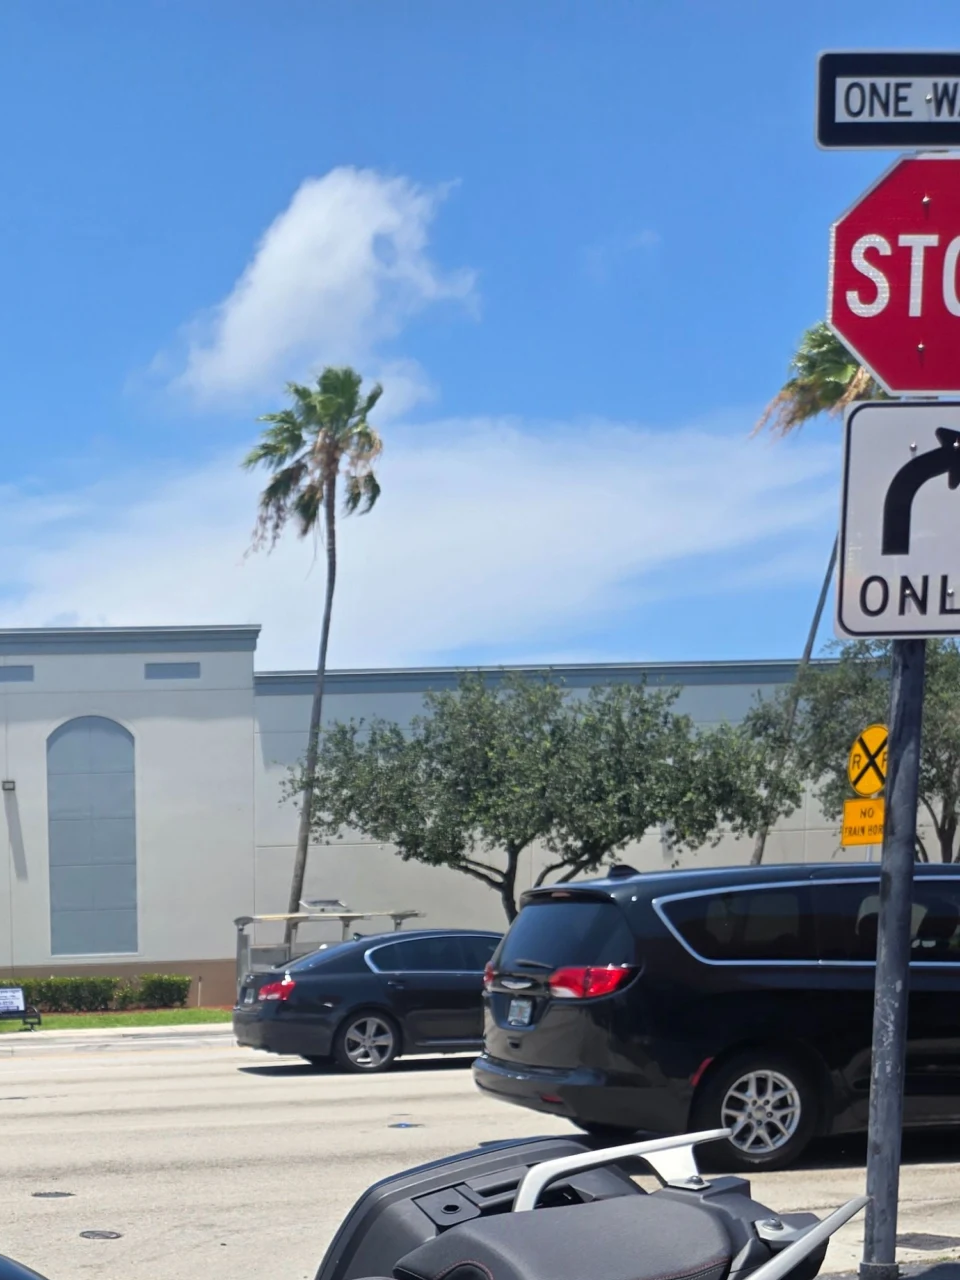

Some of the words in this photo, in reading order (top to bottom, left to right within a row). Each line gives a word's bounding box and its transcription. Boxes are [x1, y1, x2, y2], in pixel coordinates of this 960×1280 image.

[844, 81, 913, 118] ONE
[846, 234, 960, 318] ST
[860, 574, 960, 618] ONL
[852, 753, 862, 770] R
[859, 807, 875, 819] NO
[844, 825, 865, 837] TRAIN
[868, 823, 884, 836] HOR
